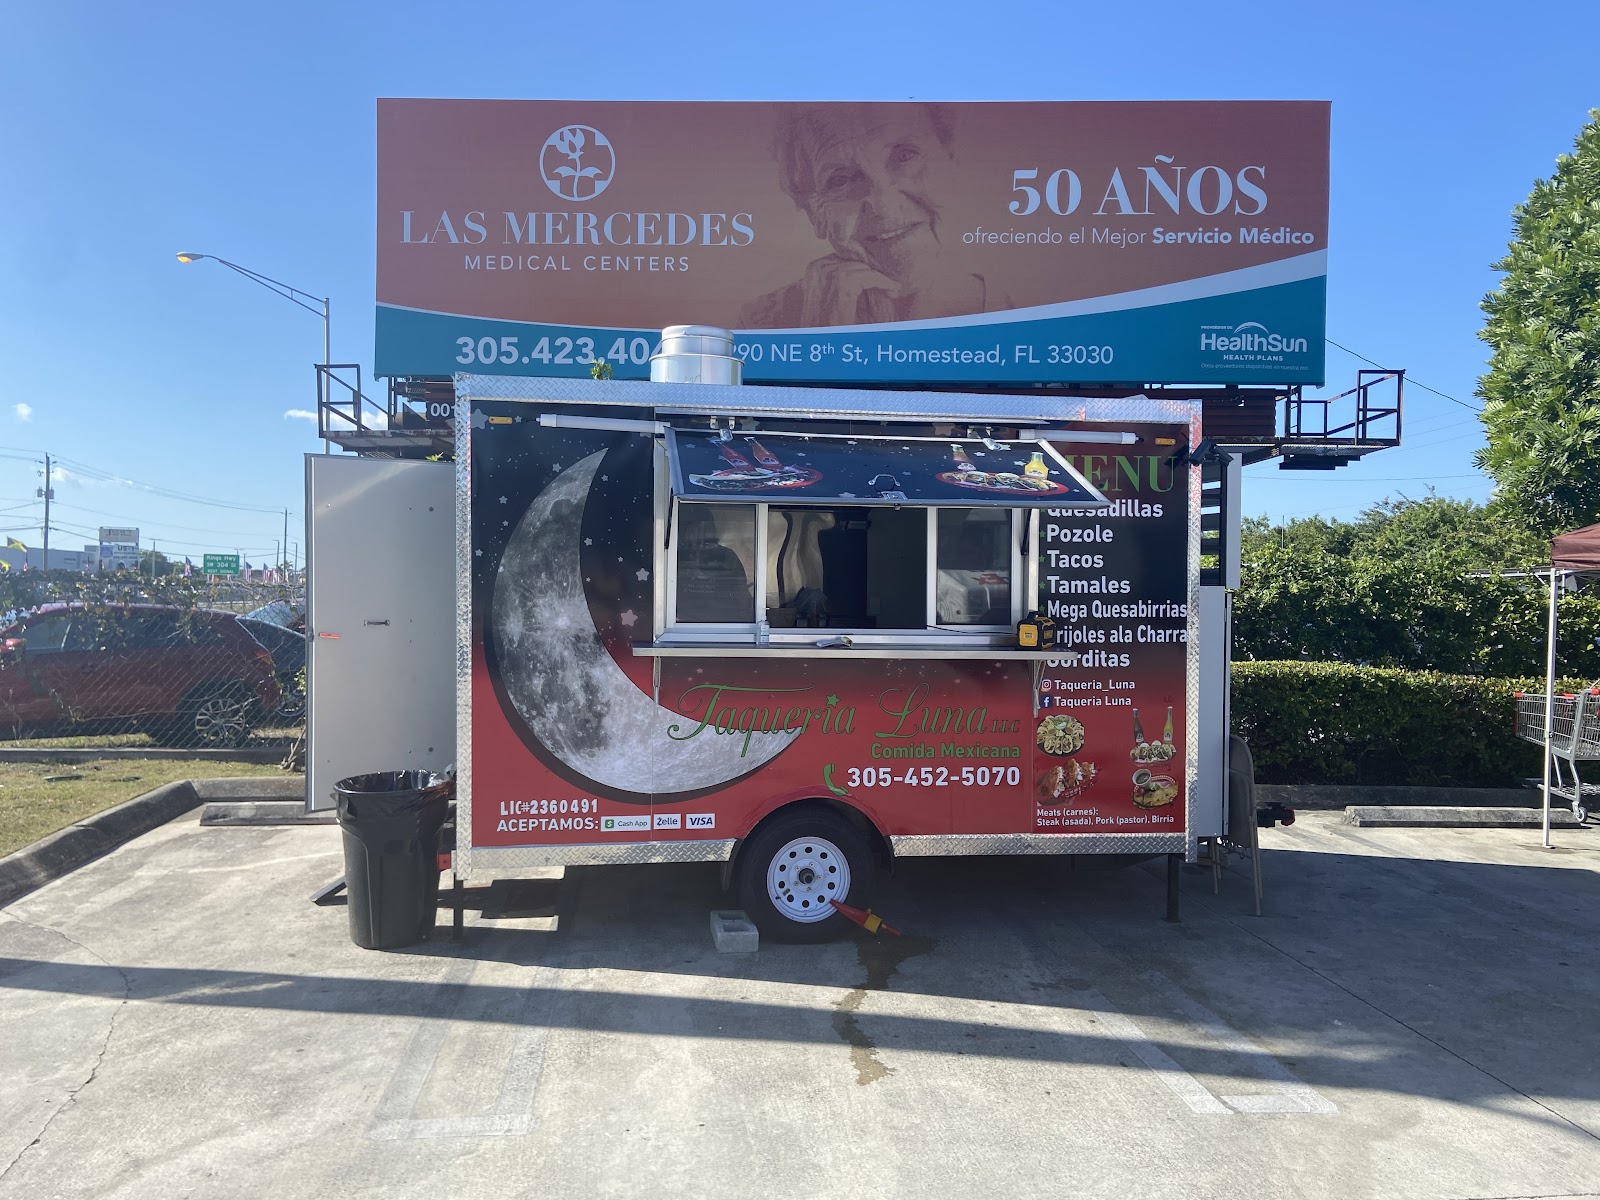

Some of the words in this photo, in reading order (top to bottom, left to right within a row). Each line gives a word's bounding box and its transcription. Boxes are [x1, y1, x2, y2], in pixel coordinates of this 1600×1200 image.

[1009, 167, 1082, 216] 50
[1092, 155, 1268, 216] AÑOS
[400, 210, 487, 244] LAS
[503, 211, 755, 247] MERCEDES
[962, 227, 1063, 245] ofreciendo
[1069, 227, 1085, 245] el
[1092, 228, 1147, 249] Mejor
[1152, 227, 1232, 245] Servicio
[1240, 227, 1315, 245] Médico
[465, 255, 571, 271] MEDICAL
[584, 256, 689, 272] CENTERS
[456, 336, 662, 365] 305.423.40
[1200, 333, 1308, 352] HealthSun
[733, 343, 764, 362] 90
[771, 344, 802, 362] NE
[809, 343, 835, 362] 8th
[841, 344, 869, 366] St,
[877, 345, 1006, 366] Homestead,
[1015, 346, 1040, 363] FL
[1047, 345, 1114, 364] 33030
[1046, 524, 1114, 543] Pozole
[1046, 550, 1104, 569] Tacos
[1046, 576, 1131, 594] Tamales
[1047, 600, 1088, 622] Mega
[1091, 599, 1187, 618] Quesabirrias
[1056, 626, 1106, 647] rijoles
[1110, 625, 1134, 644] ala
[1137, 625, 1187, 644] Charra
[1054, 679, 1136, 693] Taqueria_Luna
[1054, 696, 1102, 709] Taqueria
[1105, 695, 1132, 706] Luna
[667, 682, 857, 758] Taqueria
[874, 682, 988, 739] Luna
[990, 719, 1021, 734] LLC
[871, 742, 936, 759] Comida
[940, 742, 1021, 759] Mexicana
[847, 766, 1021, 788] 305-452-5070
[500, 798, 599, 816] LIC#2360491
[1036, 808, 1061, 817] Meats
[1063, 807, 1099, 818] (carnes):
[497, 816, 599, 833] ACEPTAMOS:
[656, 817, 678, 826] Zelle
[689, 817, 713, 826] VISA
[1037, 818, 1060, 827] Steak
[1095, 816, 1115, 825] Pork
[1151, 814, 1175, 824] Birria
